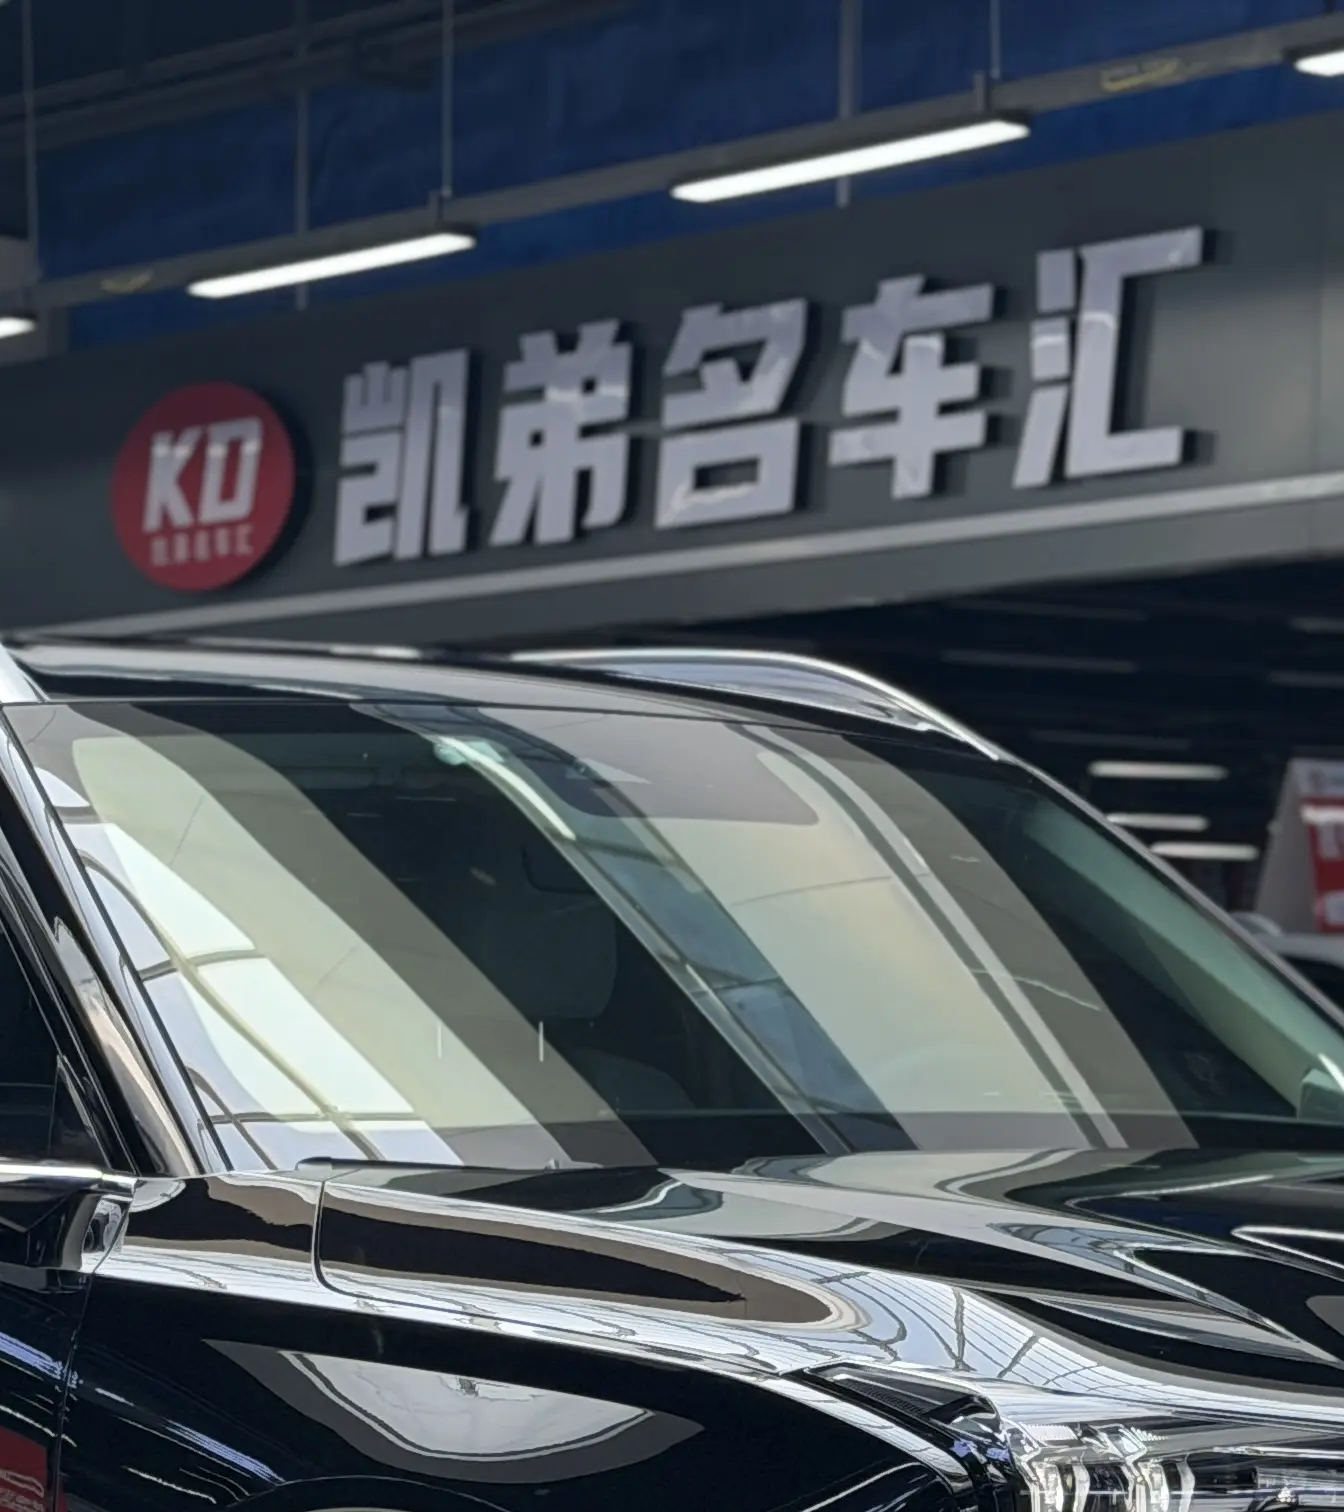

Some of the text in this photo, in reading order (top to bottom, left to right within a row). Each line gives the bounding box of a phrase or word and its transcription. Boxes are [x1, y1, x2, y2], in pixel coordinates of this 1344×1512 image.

[142, 415, 264, 534] KD
[333, 226, 1204, 566] 凯弟名车汇
